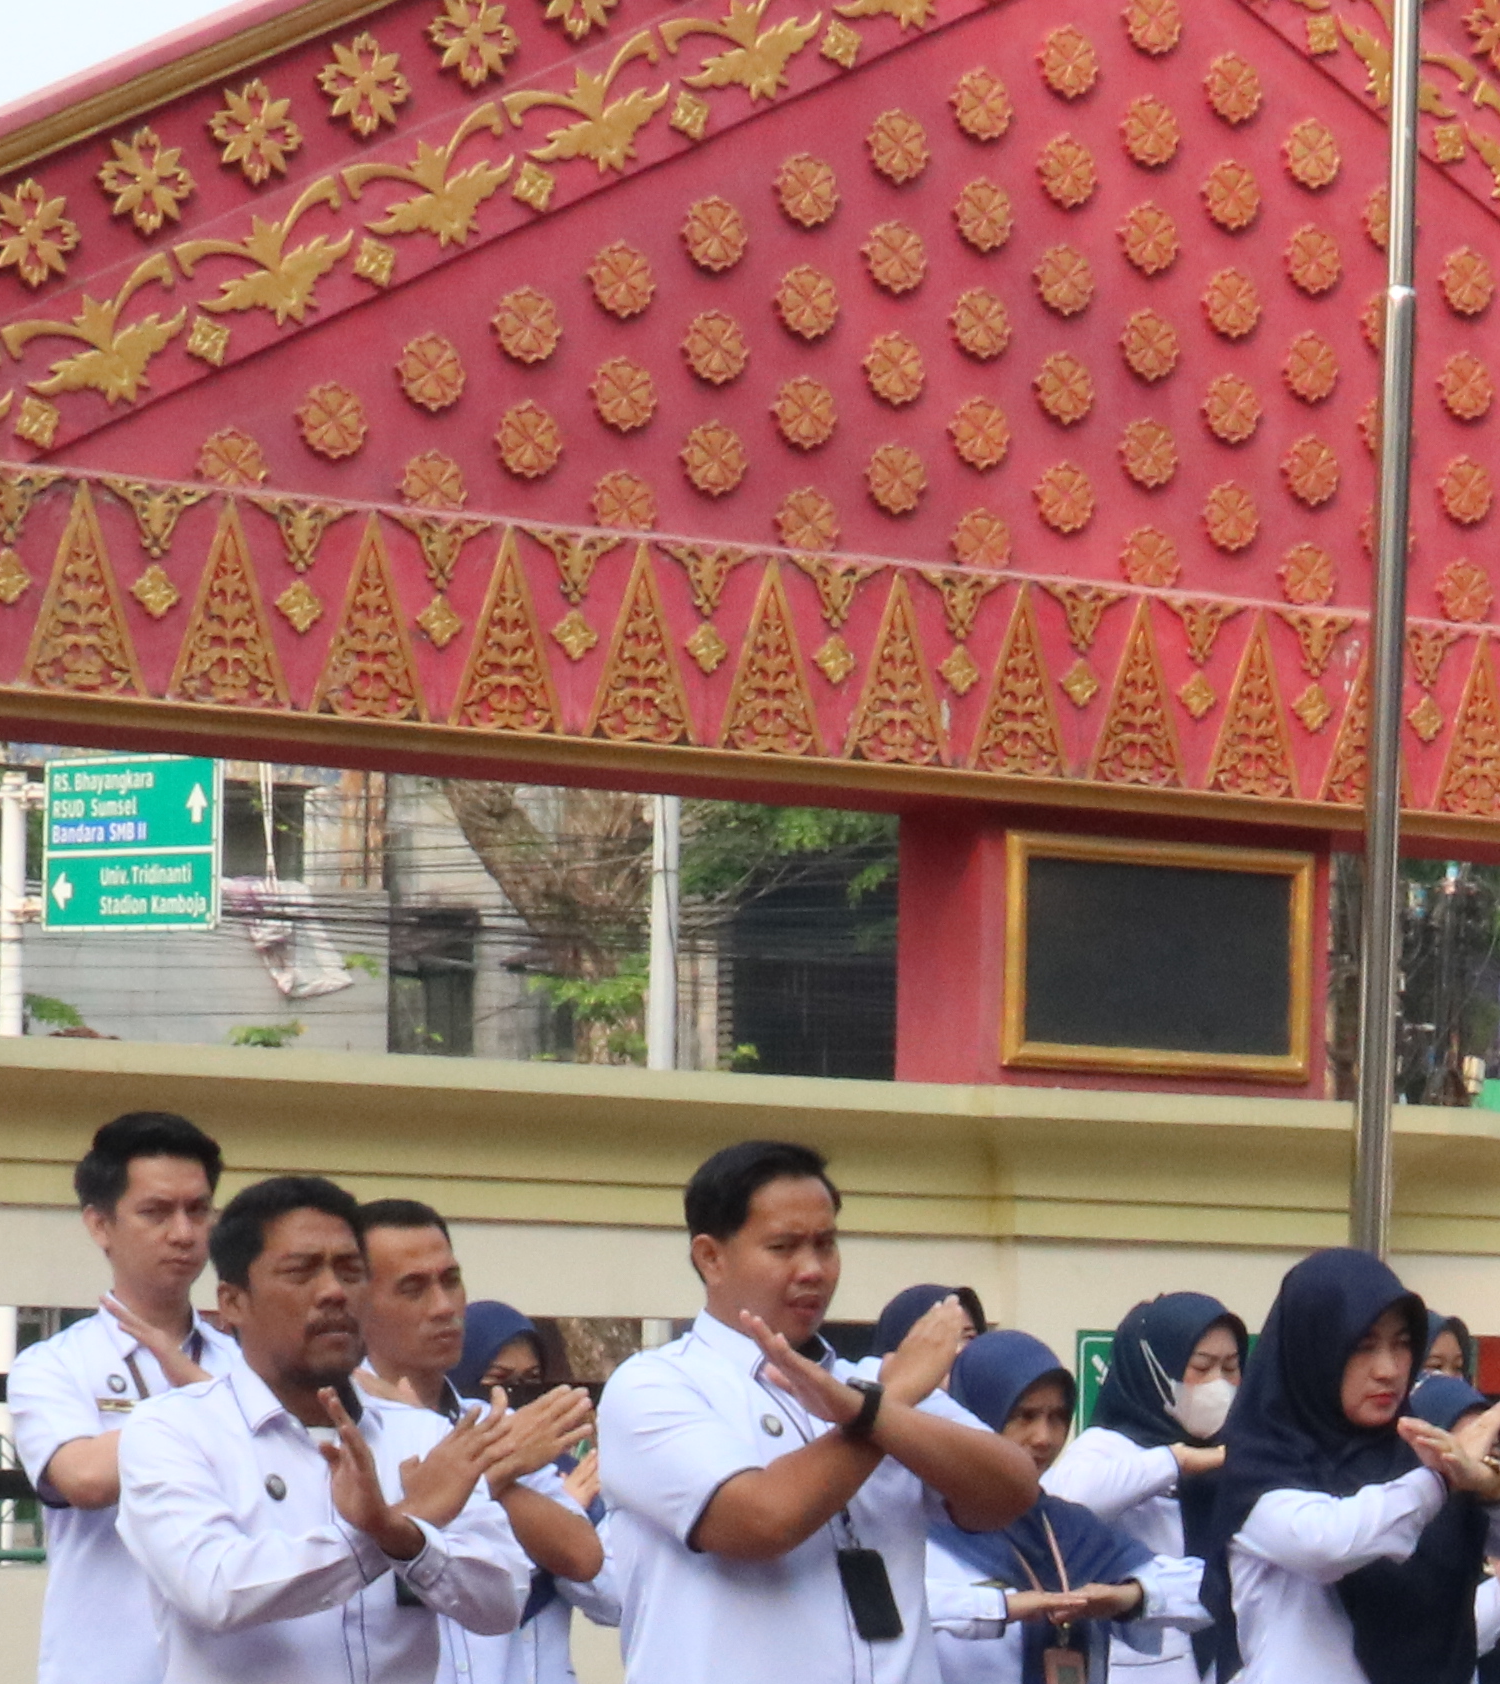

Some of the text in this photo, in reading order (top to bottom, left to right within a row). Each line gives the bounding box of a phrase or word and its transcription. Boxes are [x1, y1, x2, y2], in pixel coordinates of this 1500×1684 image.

[52, 769, 155, 795] RS. Bhayangkara
[52, 796, 138, 818] RSUD Sumsel
[52, 823, 105, 844] Bandara
[109, 821, 135, 841] SMB
[100, 862, 193, 886] Univ. Tridinanti
[99, 891, 207, 917] Stadion Kamboja
